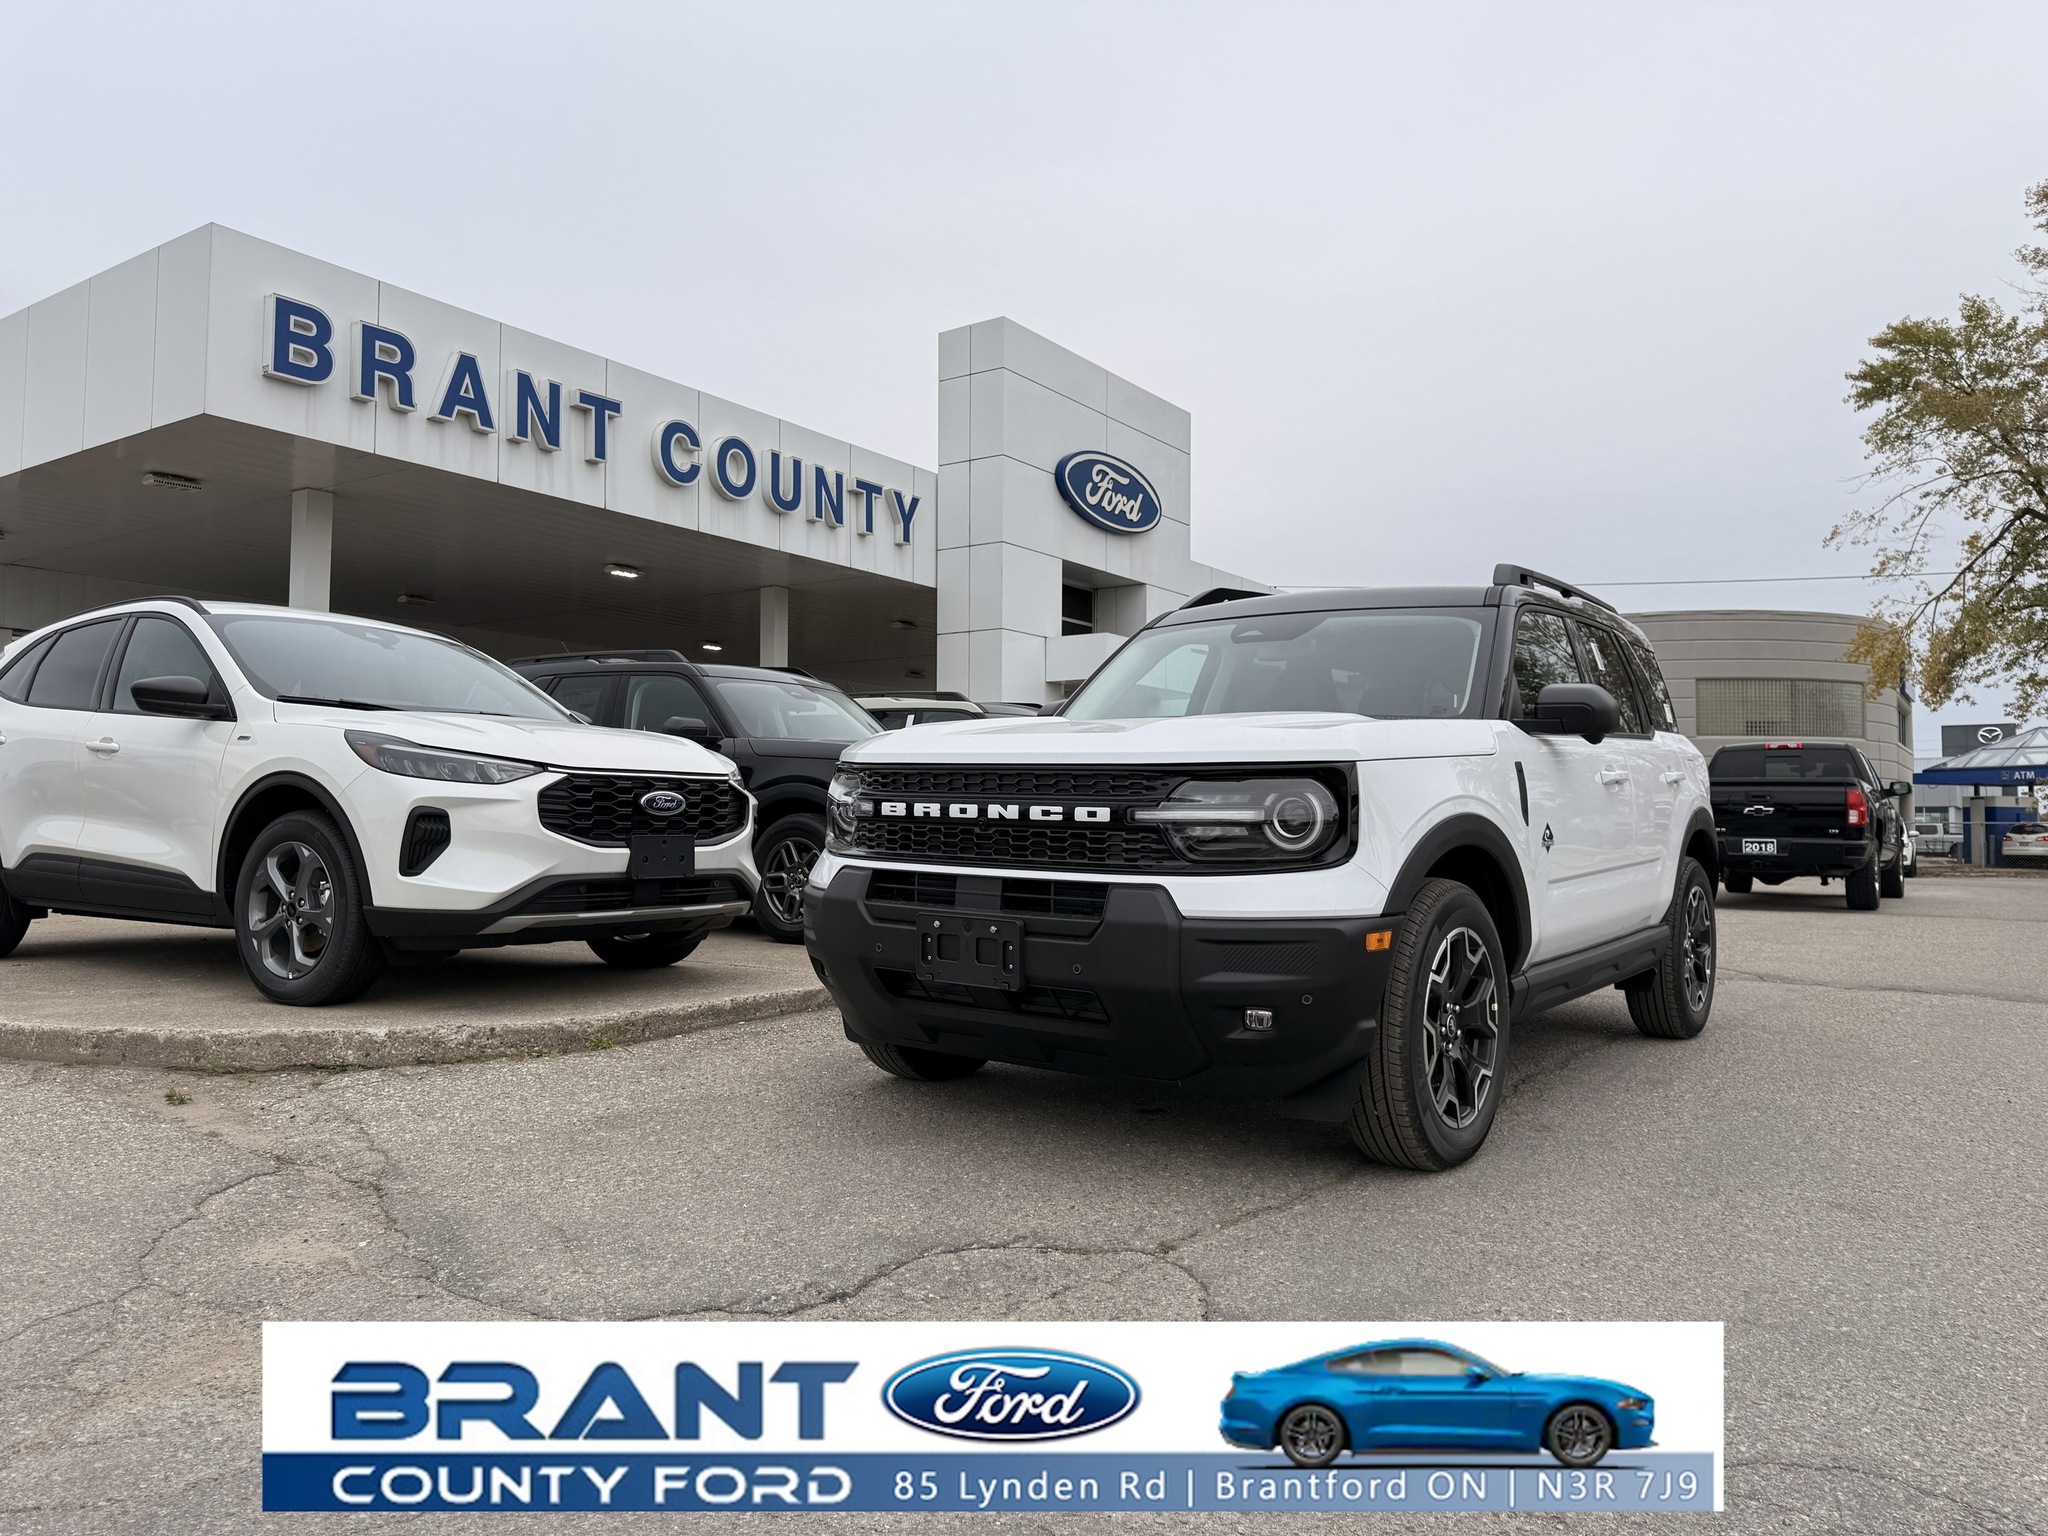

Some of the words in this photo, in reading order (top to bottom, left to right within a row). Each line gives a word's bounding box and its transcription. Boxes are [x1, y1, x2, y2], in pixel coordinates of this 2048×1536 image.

[264, 293, 623, 463] BRANT
[652, 419, 922, 545] COUNTY
[1085, 463, 1143, 523] Ford
[2014, 771, 2036, 780] ATM
[881, 802, 1111, 823] BRONCO
[1745, 842, 1774, 852] 2018
